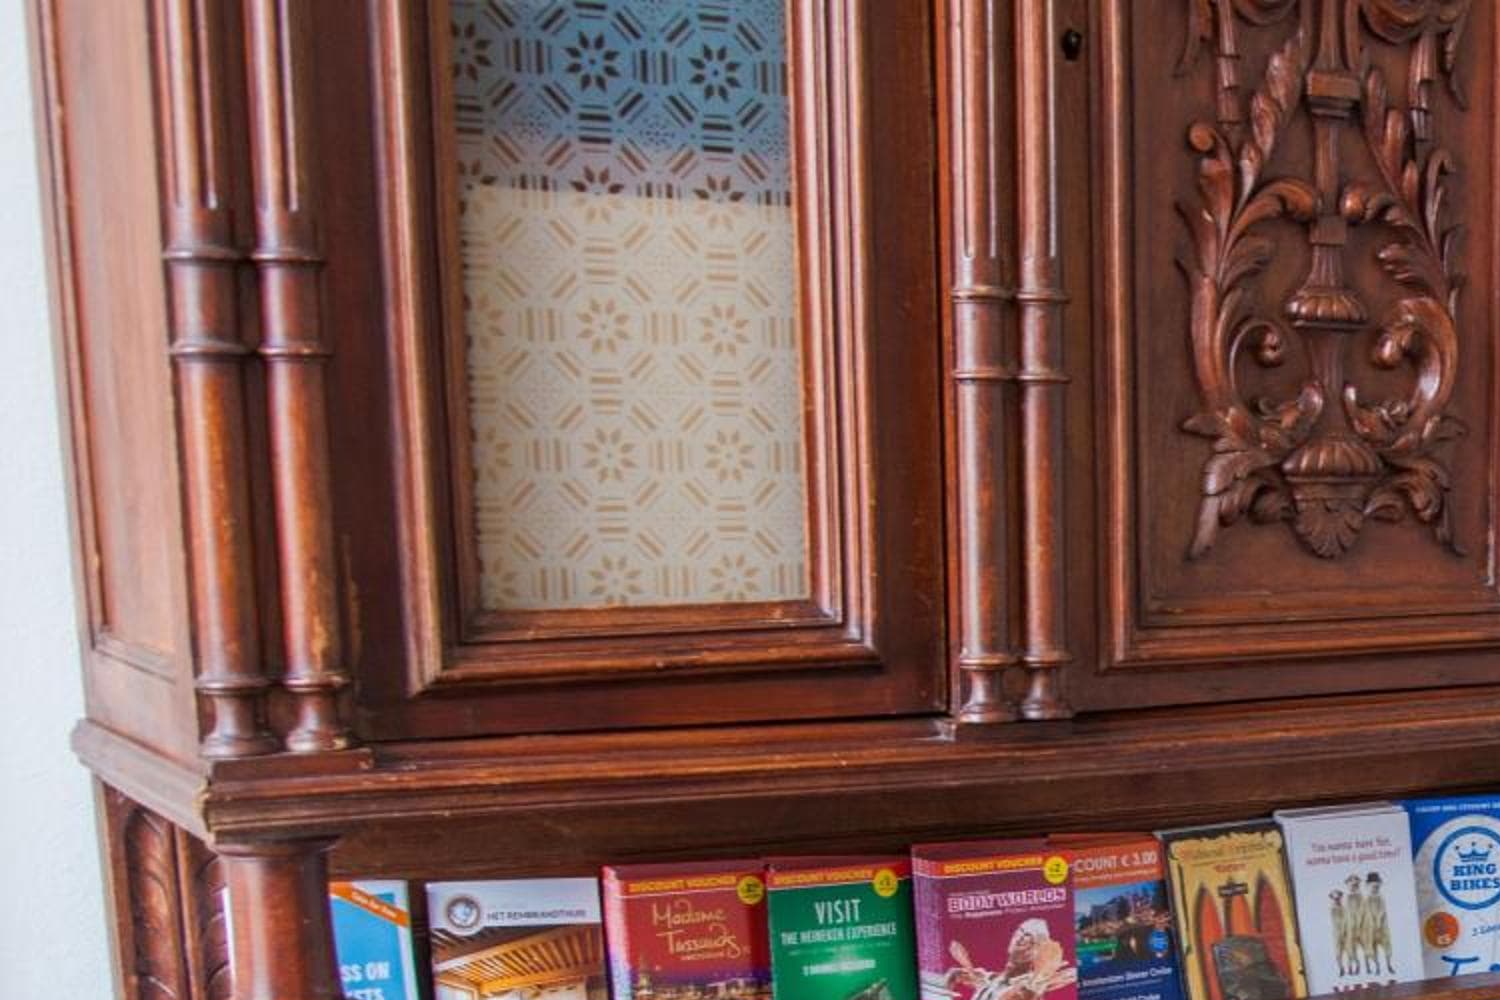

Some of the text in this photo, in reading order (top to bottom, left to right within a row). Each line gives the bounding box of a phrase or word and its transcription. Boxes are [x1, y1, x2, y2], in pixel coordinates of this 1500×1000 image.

[1073, 855, 1118, 873] COUNT
[1452, 862, 1497, 878] KING
[652, 898, 728, 929] Madame
[814, 898, 861, 925] VISIT
[655, 921, 742, 959] Tussauds
[781, 931, 798, 945] THE
[365, 960, 390, 980] ON
